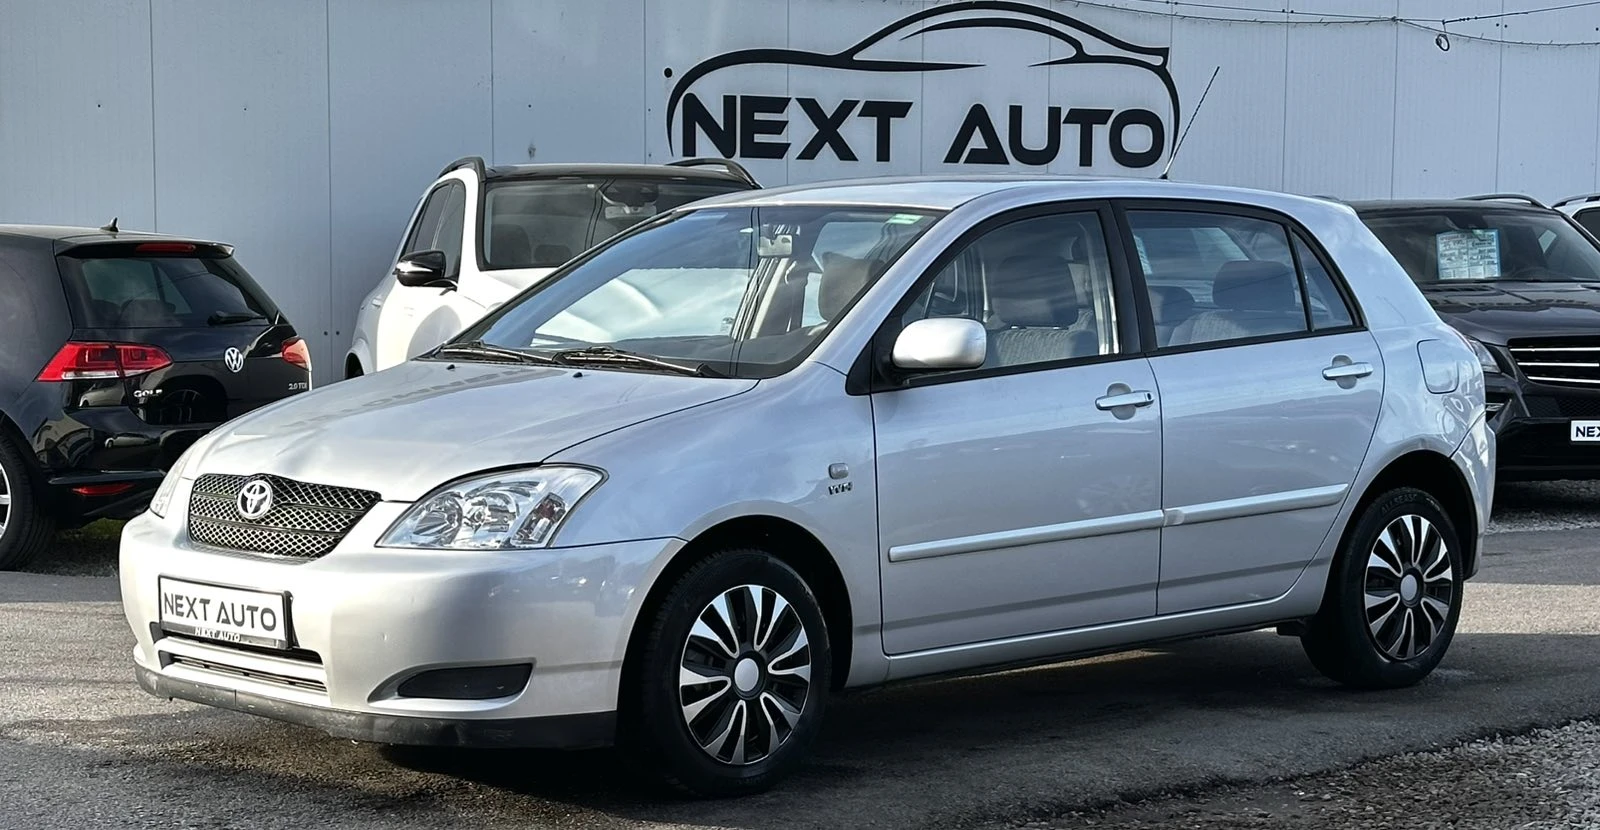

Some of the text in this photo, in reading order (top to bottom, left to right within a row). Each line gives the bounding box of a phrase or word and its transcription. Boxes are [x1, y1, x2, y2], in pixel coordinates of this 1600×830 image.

[682, 92, 1165, 169] NEXT AUTO
[134, 389, 163, 398] GOLF
[164, 592, 276, 631] NEXT AUTO
[218, 630, 241, 643] AUTO
